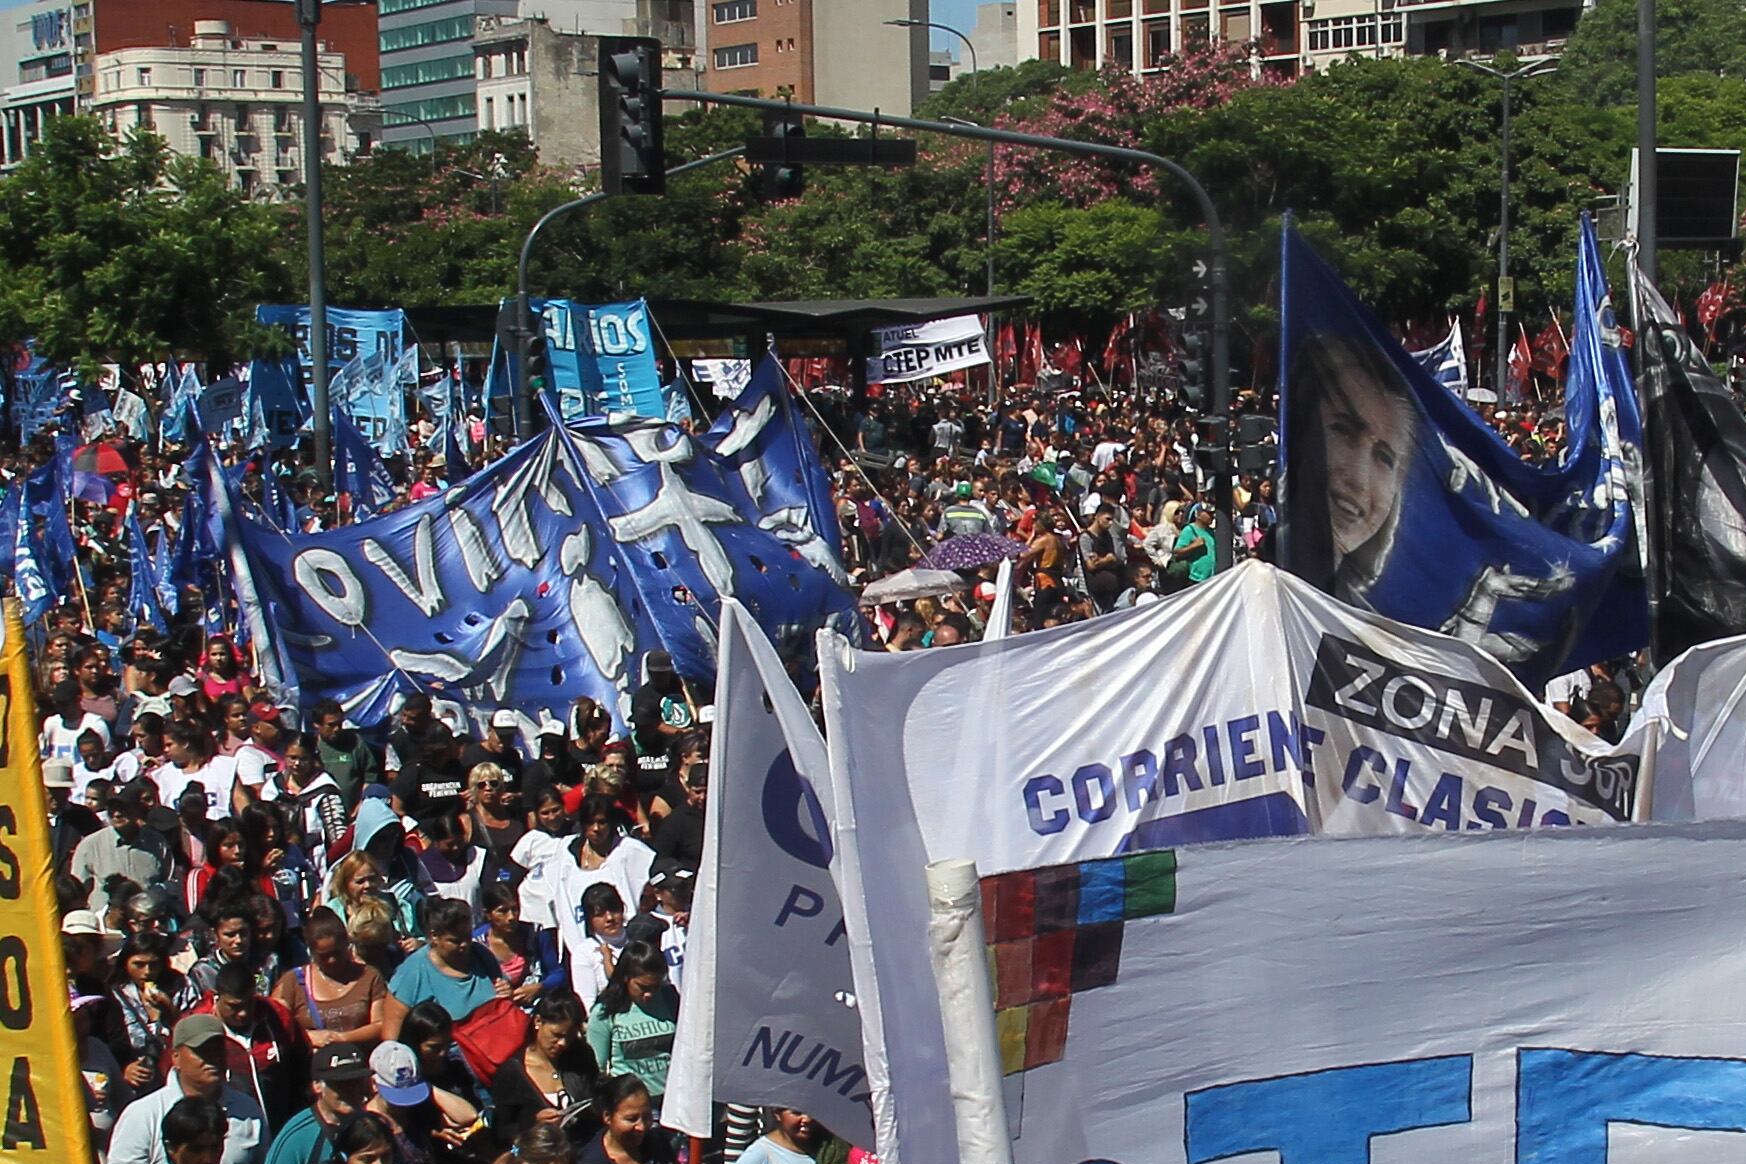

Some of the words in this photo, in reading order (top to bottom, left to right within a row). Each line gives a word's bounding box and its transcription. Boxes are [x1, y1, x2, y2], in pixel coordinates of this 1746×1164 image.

[882, 348, 931, 374] CTEP
[934, 338, 982, 363] MTE
[1334, 652, 1541, 770] ZONA
[742, 1026, 874, 1104] NUM
